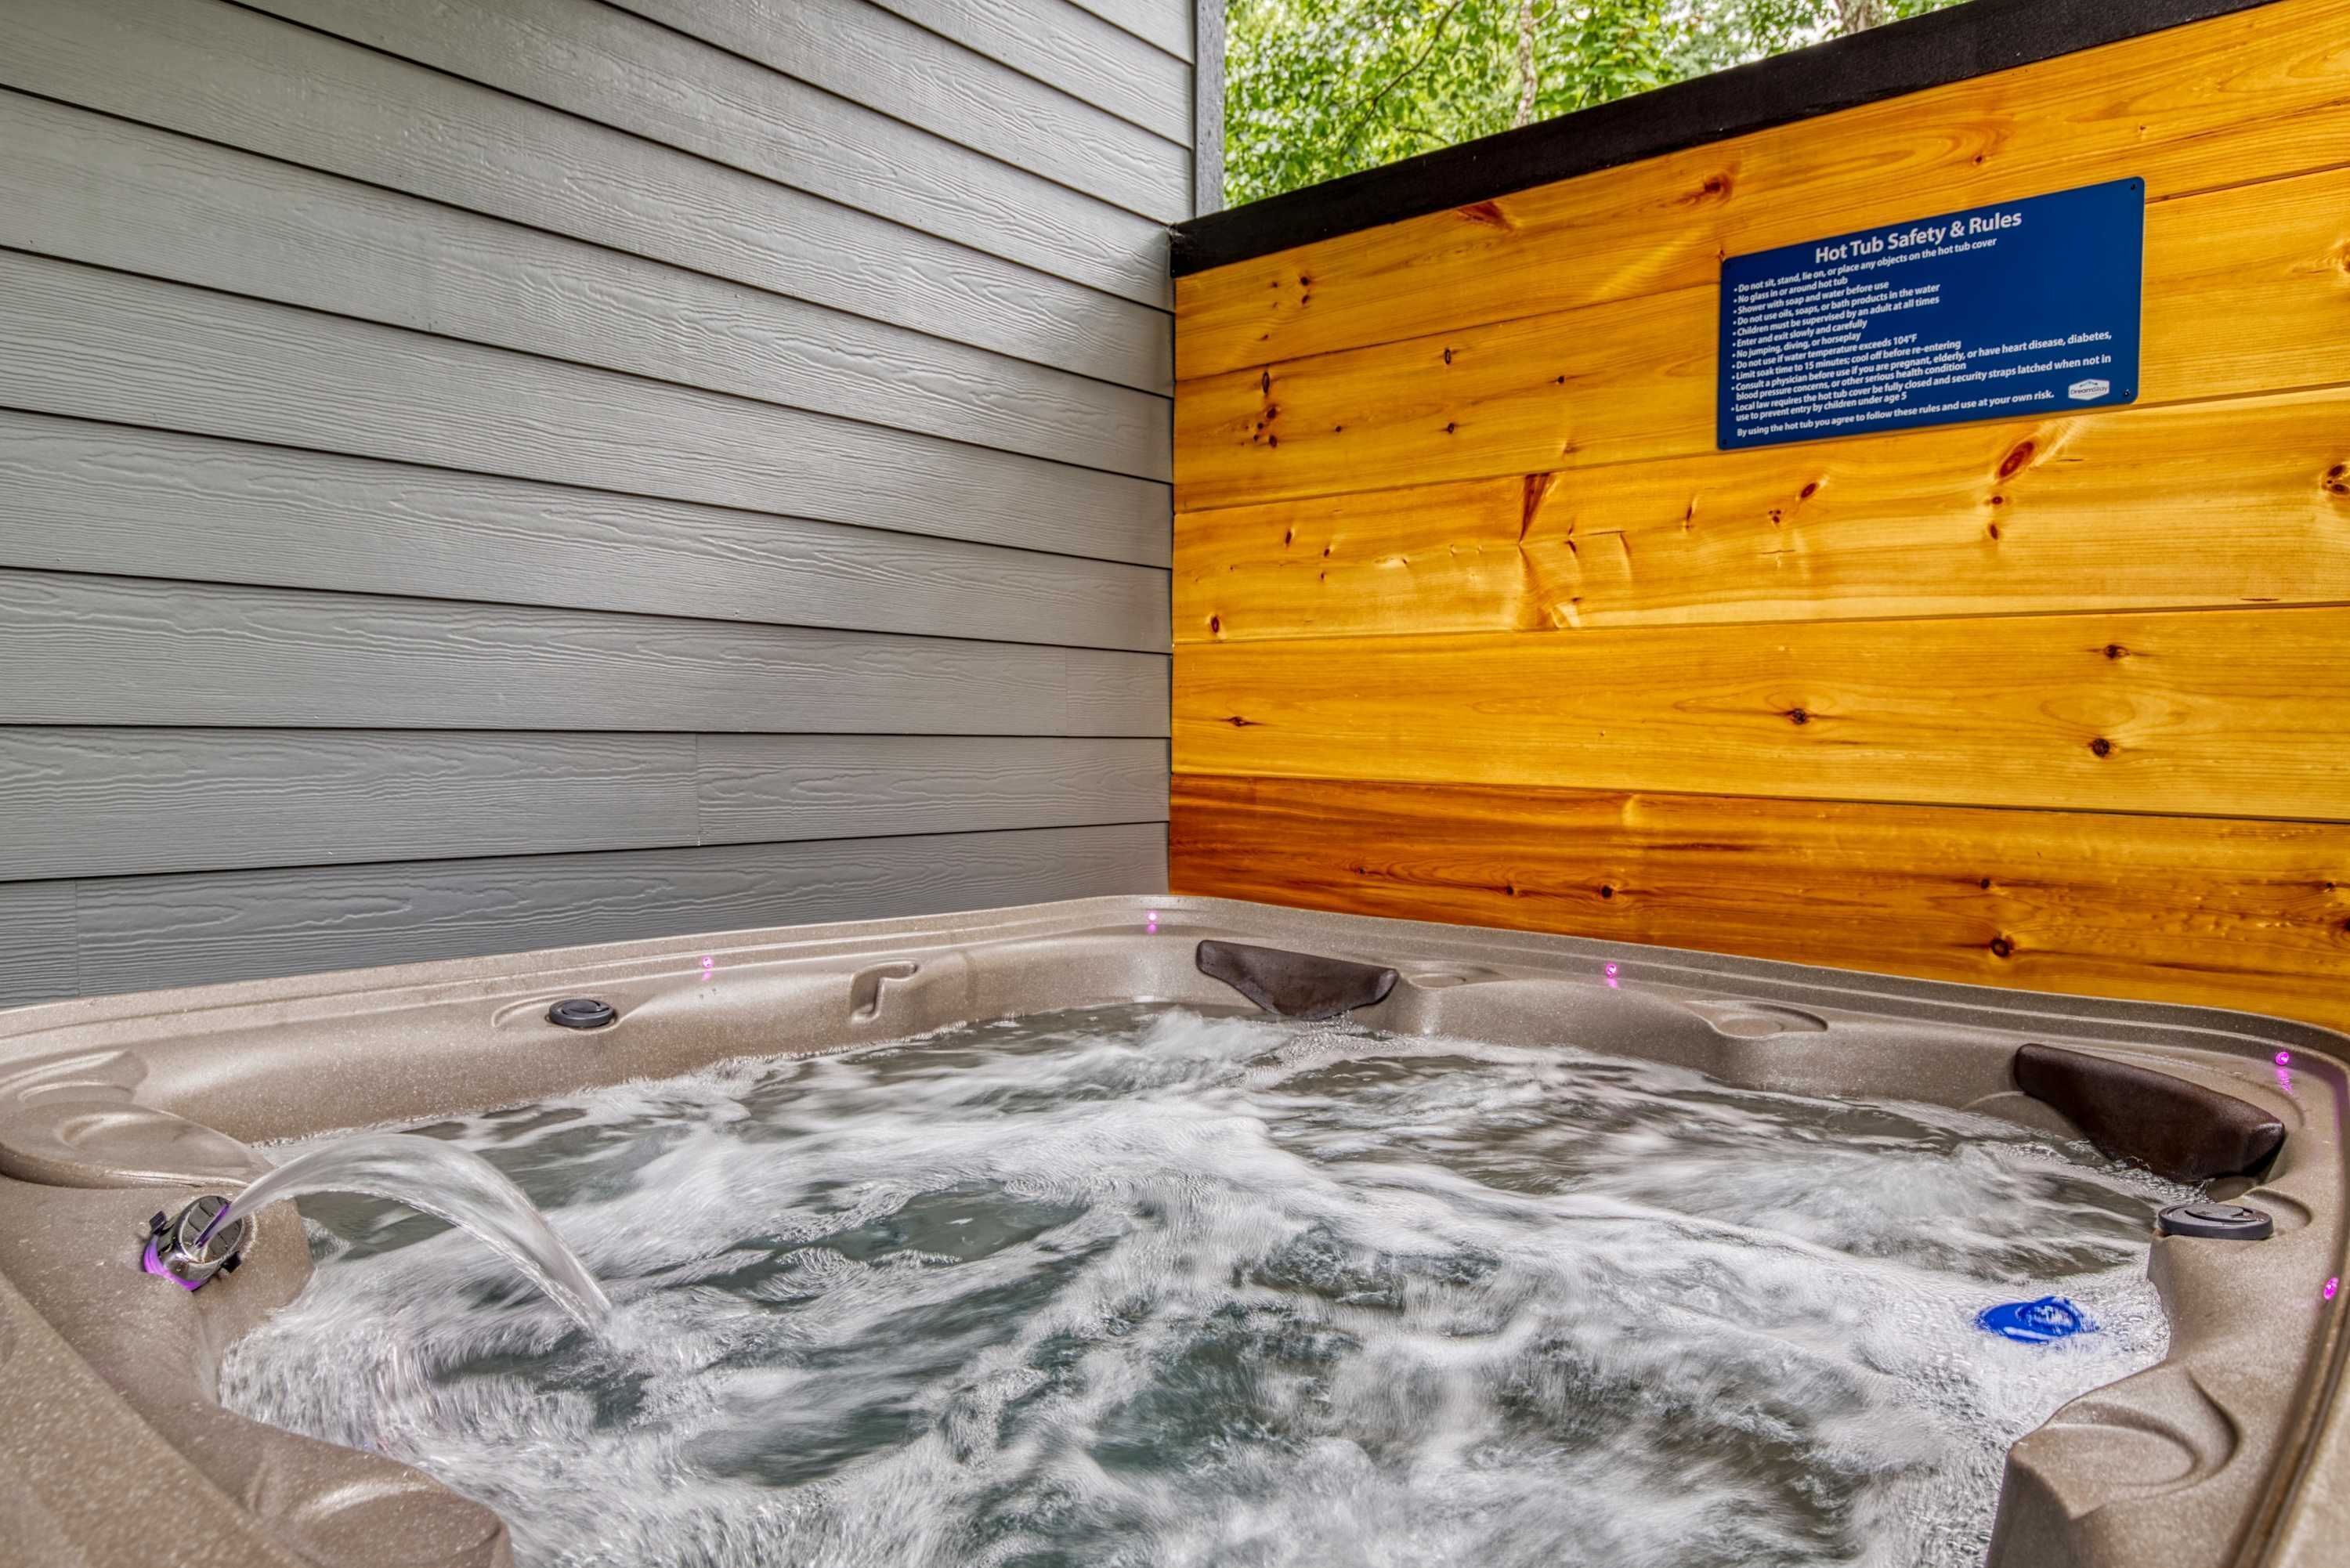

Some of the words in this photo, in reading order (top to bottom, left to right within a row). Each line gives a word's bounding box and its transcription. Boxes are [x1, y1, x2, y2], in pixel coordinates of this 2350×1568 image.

[1816, 244, 1847, 263] Hot
[1849, 237, 1884, 256] Tub
[1888, 227, 1946, 250] Safety
[1950, 221, 1965, 237] &
[1969, 212, 2022, 234] Rules
[1738, 284, 1750, 293] Do
[1750, 281, 1763, 290] not
[1765, 279, 1777, 287] sit,
[1777, 273, 1801, 285] stand,
[1802, 272, 1813, 280] lie
[1837, 264, 1860, 276] place
[1860, 261, 1876, 270] any
[1877, 255, 1907, 267] objects
[1908, 252, 1921, 261] on
[1922, 249, 1936, 258] the
[1938, 246, 1954, 255] hot
[1954, 241, 1971, 252] tub
[1972, 238, 1997, 249] cover
[1737, 303, 1766, 315] Shower
[1766, 298, 1784, 309] with
[1785, 297, 1805, 306] soap
[1805, 291, 1821, 302] and
[1822, 289, 1845, 299] water
[1846, 284, 1873, 295] before
[1874, 281, 1889, 291] use
[1737, 316, 1748, 326] Do
[1749, 314, 1762, 323] not
[1763, 313, 1777, 321] use
[1778, 309, 1794, 318] oils,
[1795, 305, 1820, 316] soaps,
[1831, 298, 1850, 309] bath
[1851, 293, 1888, 308] products
[1889, 291, 1898, 299] in
[1899, 288, 1914, 298] the
[1914, 284, 1940, 294] water
[1738, 294, 1749, 303] No
[1750, 291, 1770, 303] glass
[1788, 281, 1817, 294] around
[1818, 280, 1832, 289] hot
[1833, 276, 1848, 286] tub
[1737, 325, 1769, 336] Children
[1770, 320, 1789, 331] must
[1790, 319, 1801, 327] be
[1802, 310, 1846, 326] supervised
[1846, 309, 1857, 320] by
[1869, 303, 1893, 314] adult
[1893, 302, 1902, 310] at
[1903, 298, 1914, 309] all
[1915, 296, 1940, 306] times
[1737, 338, 1757, 347] Enter
[1758, 334, 1773, 344] and
[1773, 331, 1788, 341] exit
[1789, 327, 1815, 339] slowly
[1815, 324, 1831, 334] and
[1832, 319, 1867, 332] carefully
[1736, 370, 1755, 381] Limit
[1756, 367, 1774, 378] soak
[1775, 366, 1793, 374] time
[1805, 361, 1814, 370] 15
[1815, 357, 1850, 368] minutes;
[1851, 352, 1869, 363] cool
[1870, 350, 1882, 360] off
[1883, 348, 1911, 359] before
[1911, 341, 1961, 354] re-entering
[1736, 380, 1764, 391] Consult
[1771, 374, 1808, 388] physician
[1809, 370, 1835, 381] before
[1851, 365, 1858, 374] if
[1858, 366, 1875, 375] you
[1890, 356, 1932, 371] pregnant,
[1932, 351, 1965, 363] elderly,
[1967, 350, 1977, 359] or
[1979, 347, 2001, 356] have
[2001, 342, 2027, 353] heart
[2028, 338, 2066, 349] disease,
[2067, 331, 2112, 344] diabetes,
[1737, 349, 1748, 358] No
[1748, 345, 1783, 358] jumping,
[1784, 341, 1810, 351] diving,
[1821, 332, 1861, 345] horseplay
[1748, 359, 1762, 367] not
[1777, 354, 1784, 363] if
[1784, 352, 1806, 362] water
[1807, 345, 1858, 358] temperature
[1858, 338, 1892, 351] exceeds
[1735, 401, 1755, 412] Local
[1770, 396, 1802, 407] requires
[1803, 394, 1817, 403] the
[1818, 392, 1832, 400] hot
[1833, 389, 1848, 399] tub
[1849, 388, 1871, 397] cover
[1872, 385, 1883, 393] be
[1884, 381, 1904, 392] fully
[1904, 377, 1932, 389] closed
[1933, 374, 1950, 385] and
[1951, 371, 1987, 383] security
[1988, 368, 2016, 378] straps
[2017, 361, 2052, 374] latched
[2054, 359, 2081, 369] when
[2082, 356, 2099, 366] not
[2102, 354, 2111, 363] in
[1736, 390, 1759, 401] blood
[1759, 387, 1792, 399] pressure
[1792, 382, 1830, 393] concerns,
[1841, 377, 1864, 386] other
[1864, 372, 1895, 383] serious
[1896, 367, 1924, 378] health
[1925, 363, 1966, 374] condition
[1737, 428, 1748, 437] By
[1748, 426, 1770, 435] using
[1770, 424, 1784, 432] the
[1799, 419, 1814, 428] tub
[1814, 419, 1831, 428] you
[1831, 416, 1855, 426] agree
[1866, 411, 1893, 420] follow
[1893, 408, 1918, 417] these
[1918, 404, 1940, 414] rules
[1941, 401, 1959, 411] and
[1978, 398, 1988, 406] at
[1989, 396, 2011, 407] your
[2012, 394, 2033, 403] own
[2034, 390, 2054, 399] risk.
[1759, 407, 1789, 420] prevent
[1790, 406, 1812, 414] entry
[1813, 403, 1823, 413] by
[1824, 399, 1857, 410] children
[1857, 395, 1883, 406] under
[1883, 394, 1900, 403] age
[1901, 391, 1907, 400] 5
